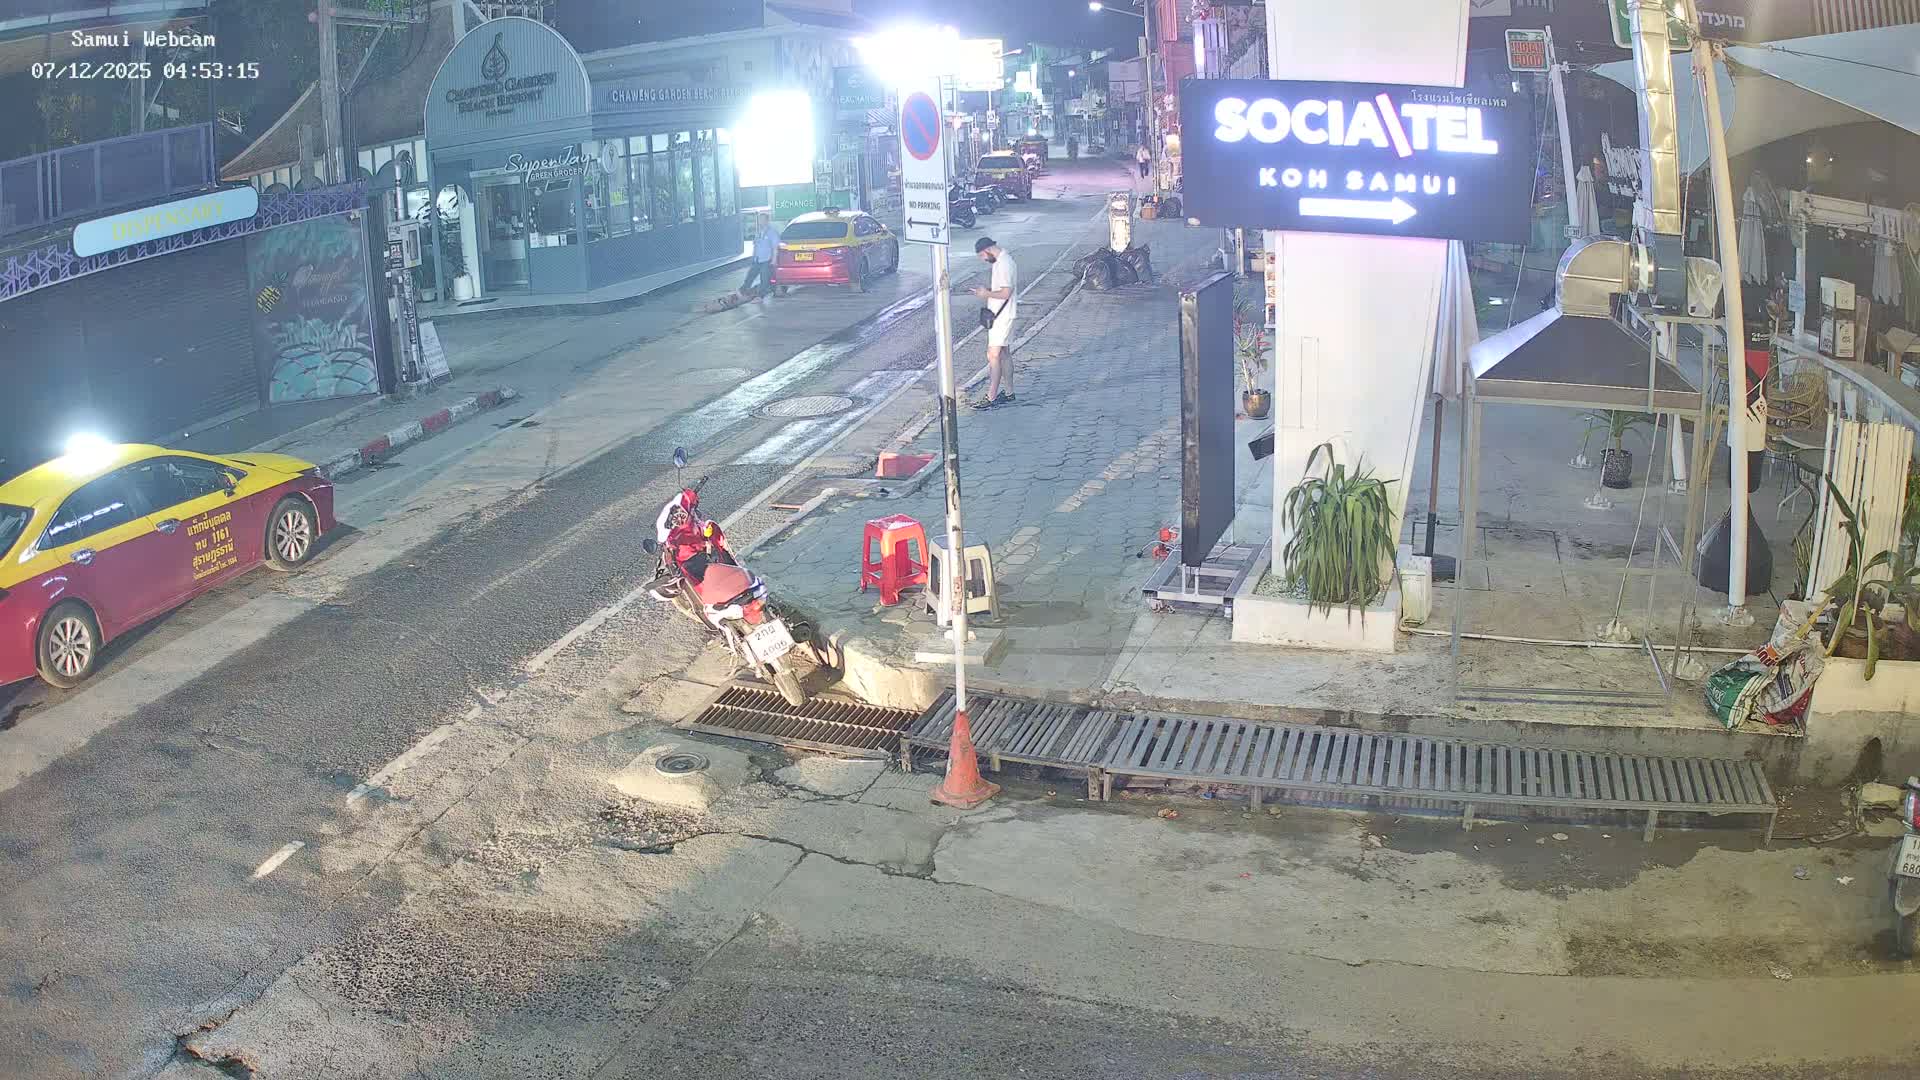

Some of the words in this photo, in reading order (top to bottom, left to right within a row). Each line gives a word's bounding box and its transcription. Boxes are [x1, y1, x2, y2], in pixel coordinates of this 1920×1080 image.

[1513, 55, 1545, 67] FOOD
[612, 88, 656, 103] CHAWENG
[659, 87, 691, 101] GARDEN
[1259, 167, 1328, 189] KOH
[1345, 171, 1456, 195] SAMUI
[776, 200, 814, 209] EXCHANGE
[918, 202, 941, 210] PARKING
[112, 200, 224, 241] DISPENSARY
[212, 526, 230, 544] 1161
